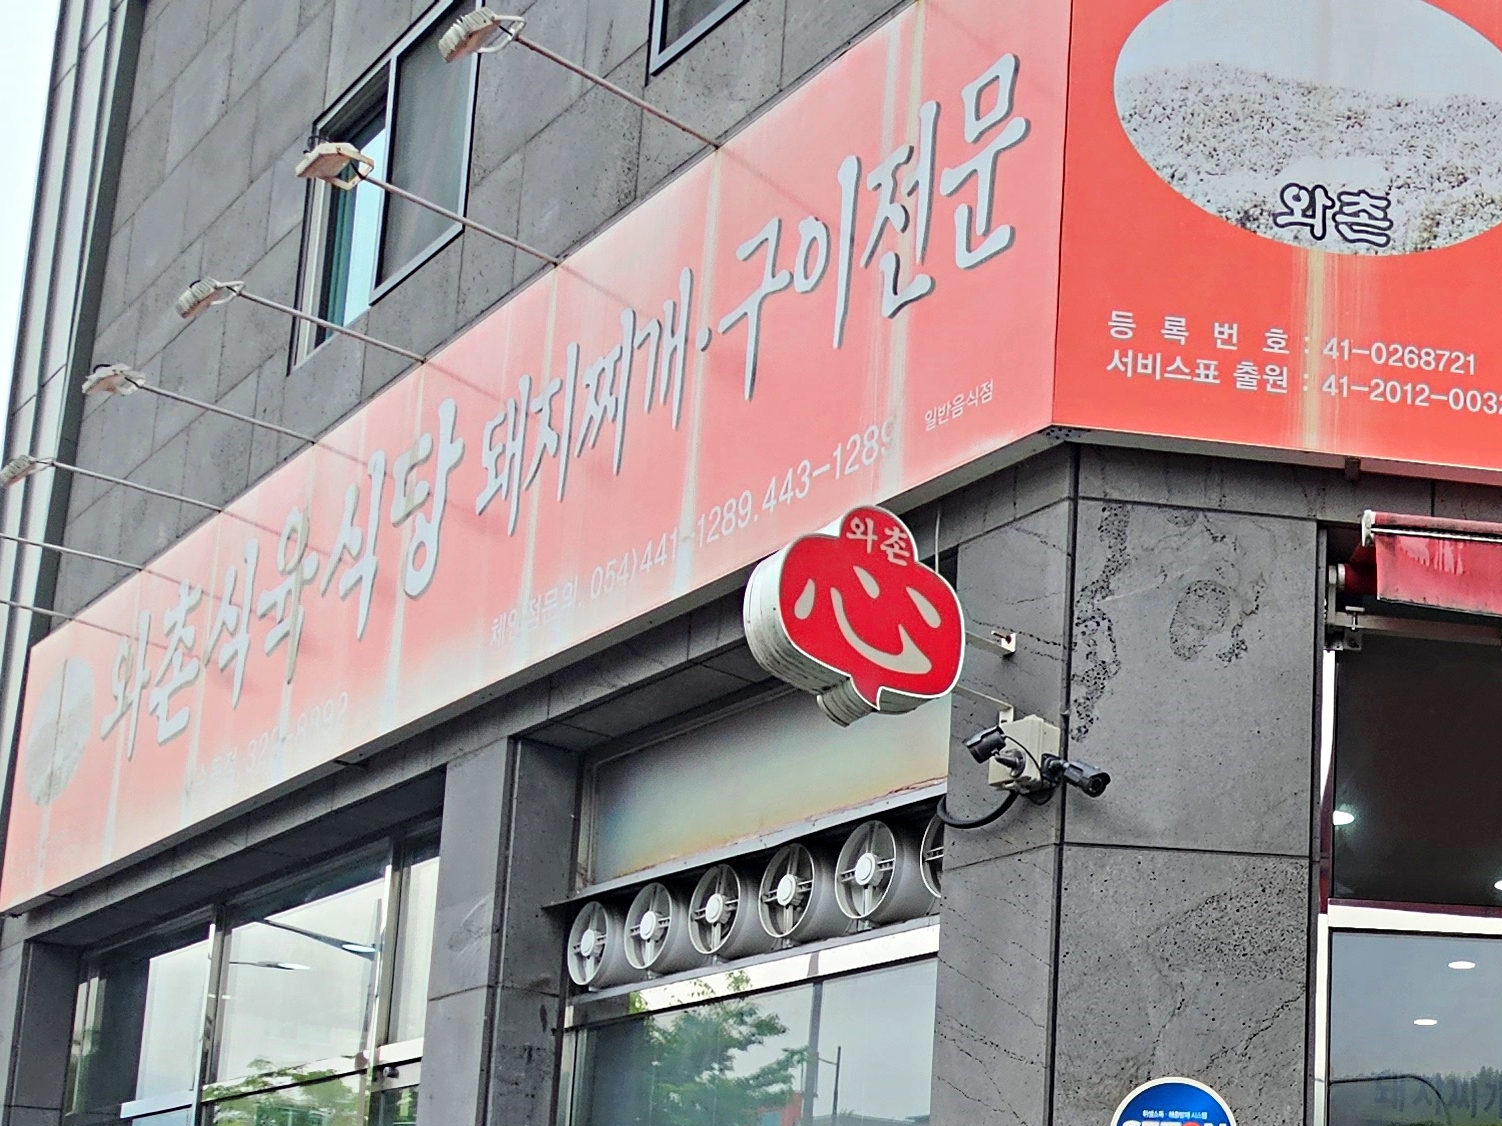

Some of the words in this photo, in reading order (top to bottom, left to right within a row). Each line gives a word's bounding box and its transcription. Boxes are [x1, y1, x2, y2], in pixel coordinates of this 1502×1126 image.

[1273, 183, 1394, 248] 와촌
[1105, 349, 1221, 384] 서비스표
[1232, 362, 1289, 394] 출원
[1323, 337, 1477, 375] 41-0268721
[922, 379, 995, 432] 일반음식점
[846, 516, 910, 567] 와촌
[101, 397, 465, 762] 와촌식육식당
